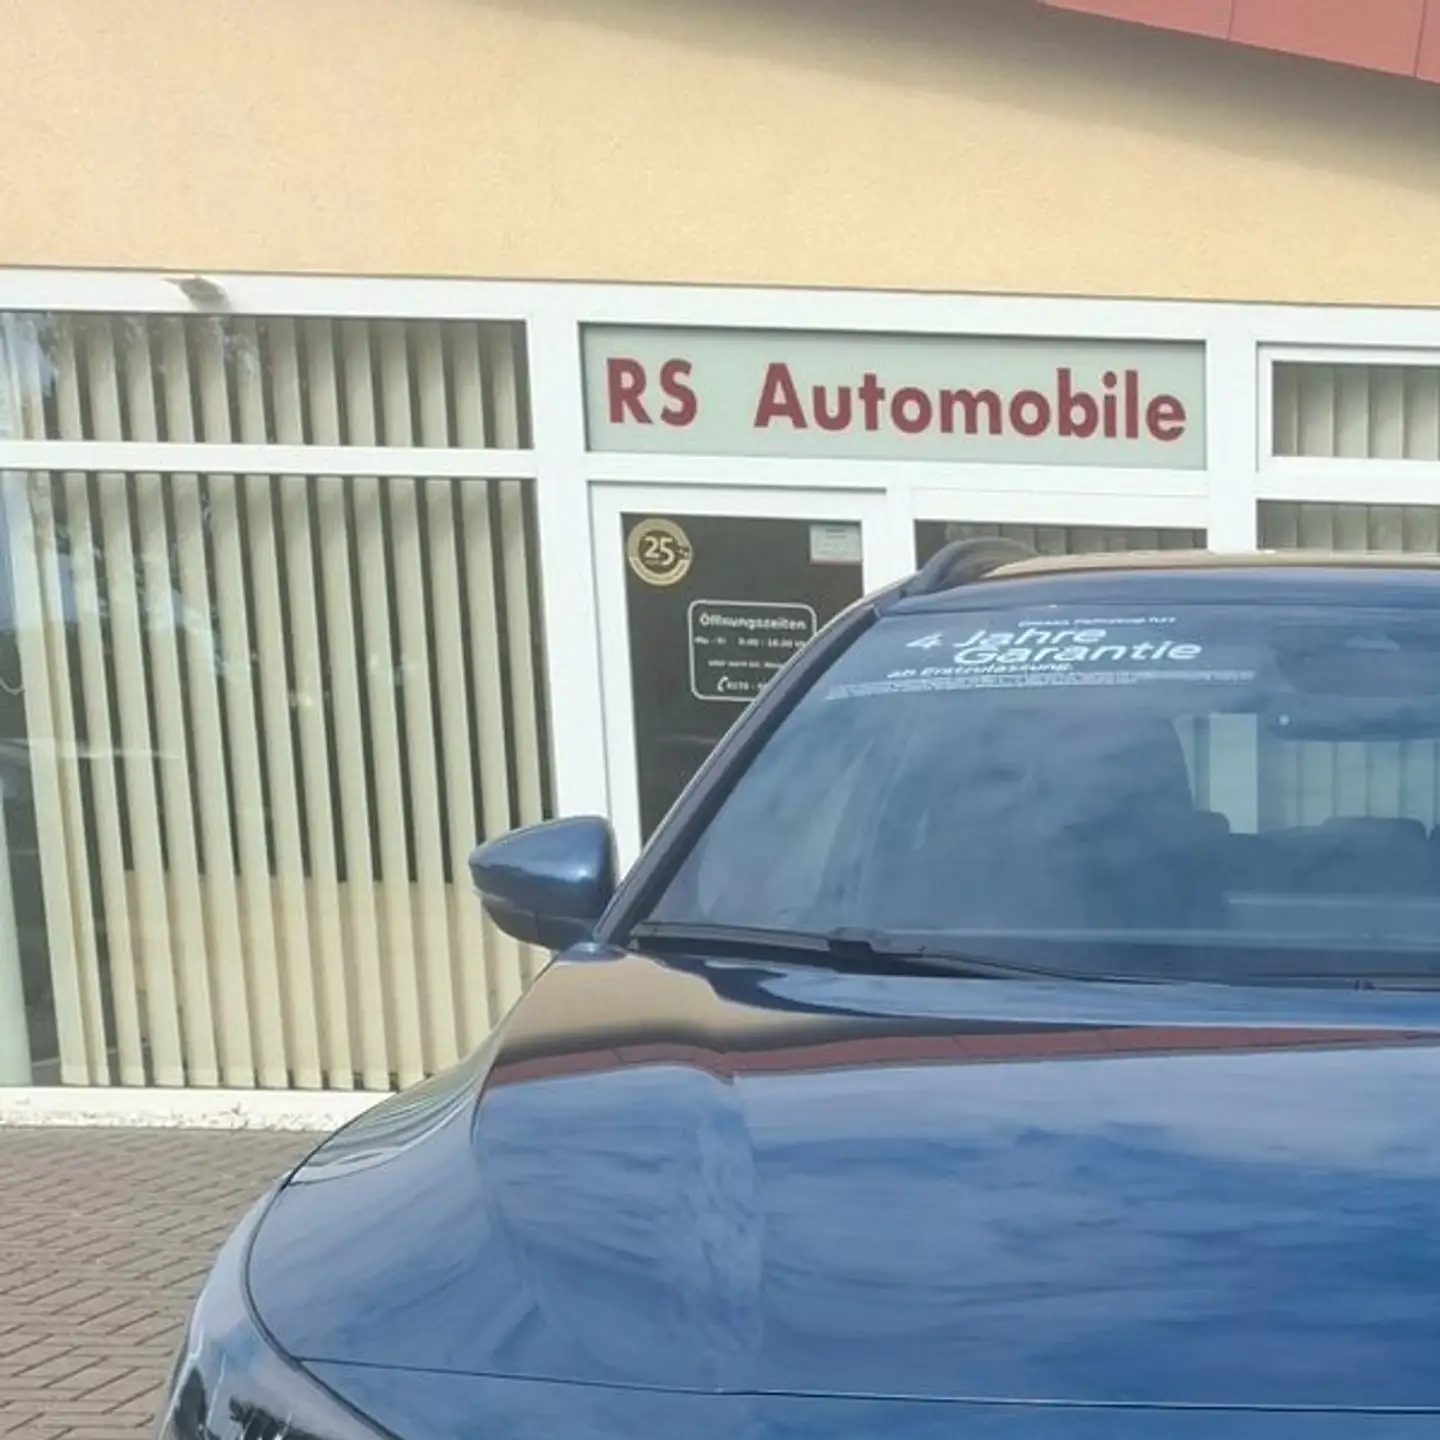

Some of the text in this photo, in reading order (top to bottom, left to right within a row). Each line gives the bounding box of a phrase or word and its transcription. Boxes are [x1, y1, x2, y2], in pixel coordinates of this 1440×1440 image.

[606, 356, 1187, 442] RS Automobile
[643, 535, 676, 566] 25
[699, 612, 807, 631] Öffnungszeiten
[952, 628, 1107, 648] Jahre
[953, 640, 1203, 665] Garantie
